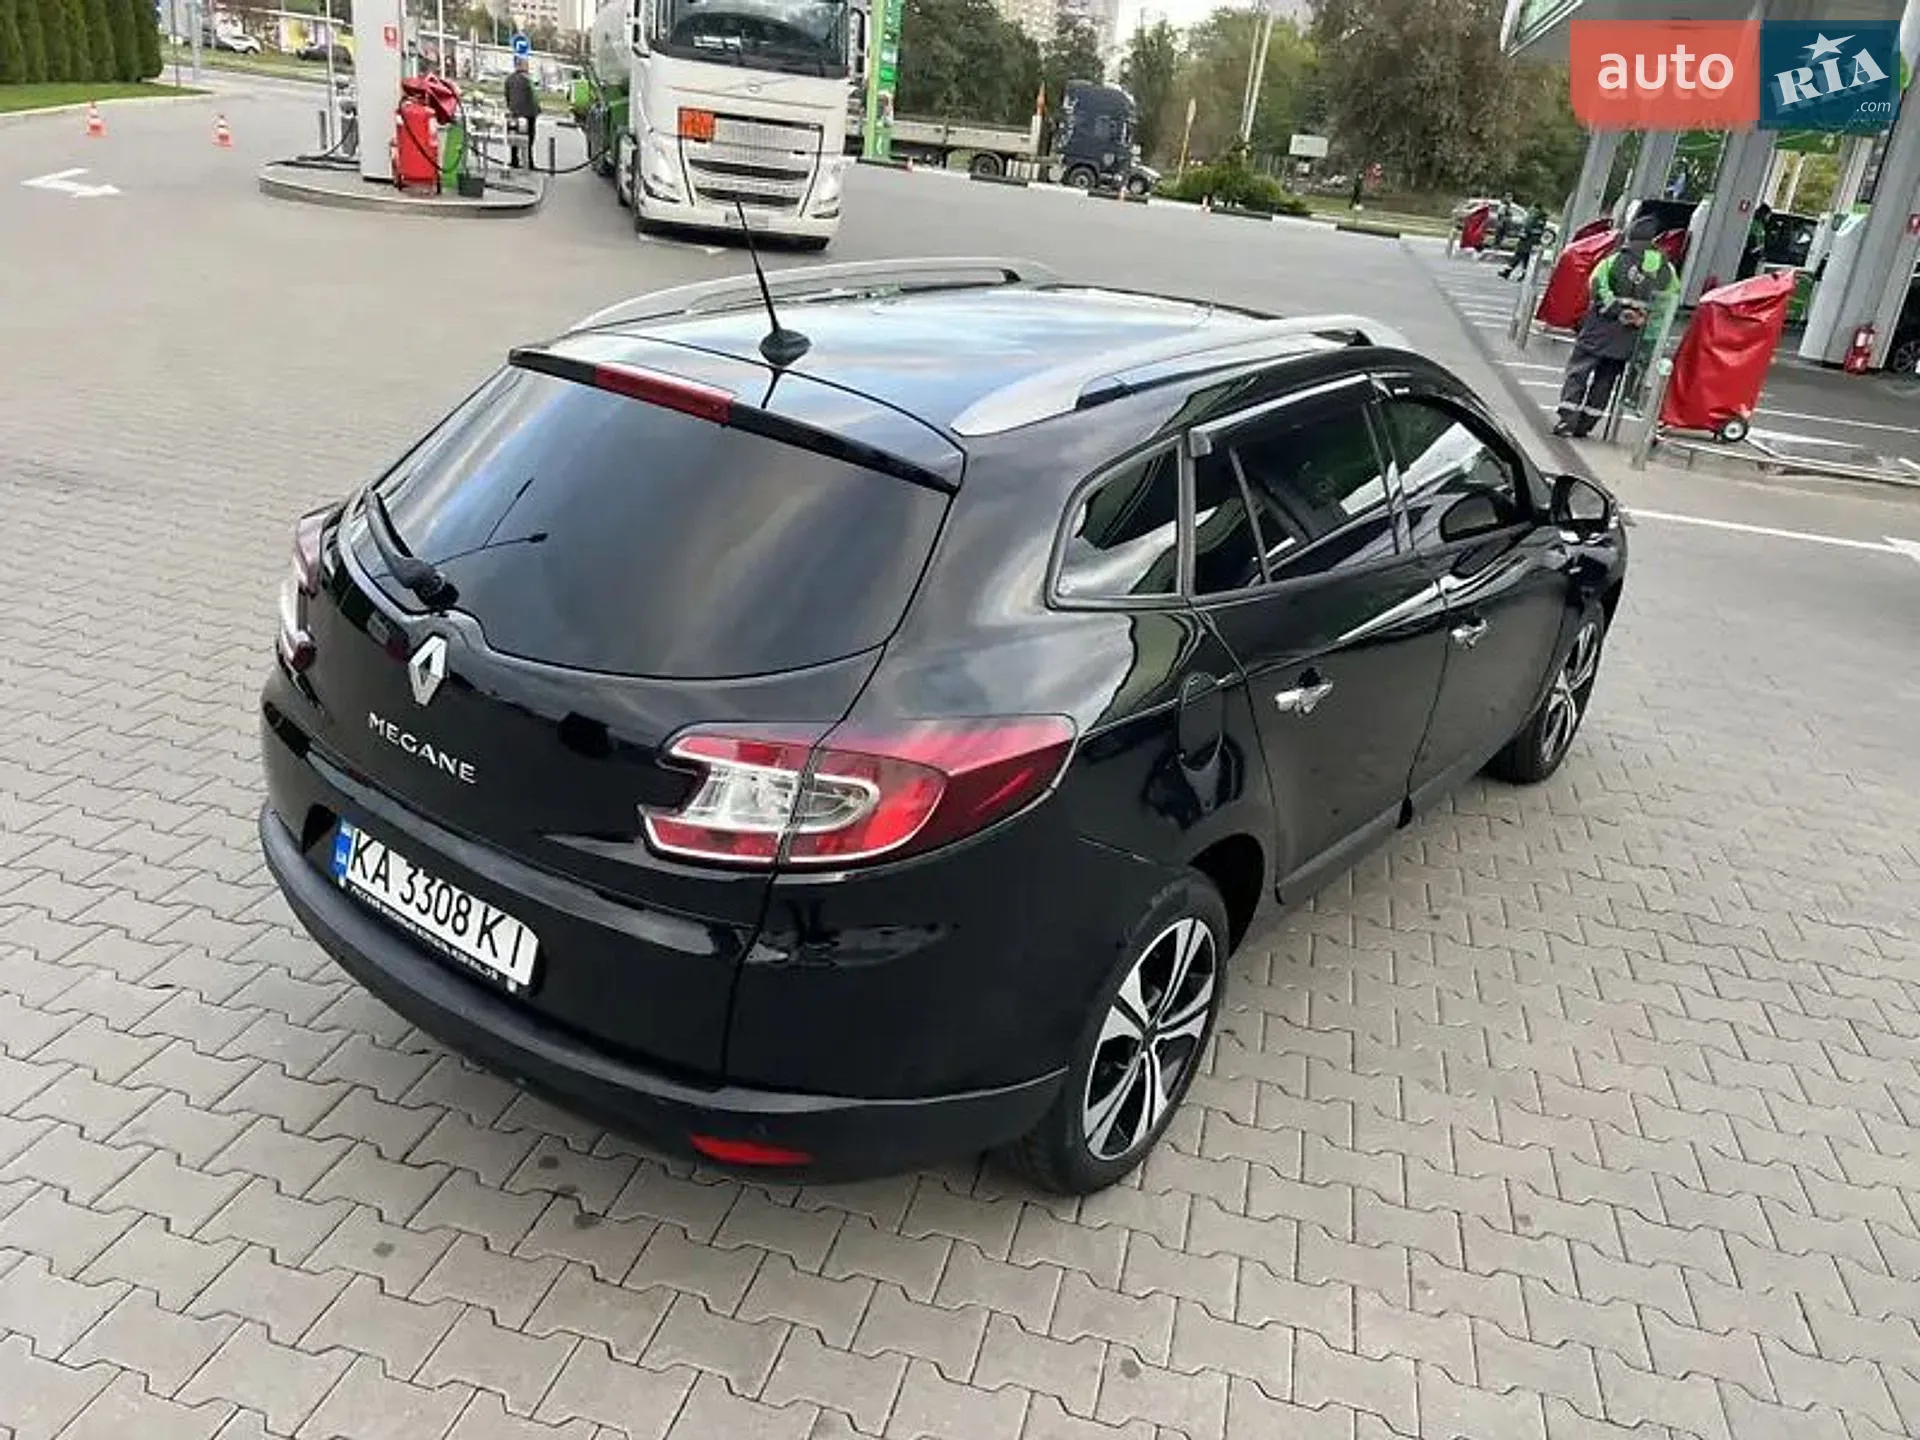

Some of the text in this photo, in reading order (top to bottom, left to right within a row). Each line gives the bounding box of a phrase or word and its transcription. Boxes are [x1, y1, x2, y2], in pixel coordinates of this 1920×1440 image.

[368, 711, 477, 784] MEGANE
[350, 829, 391, 894] KA
[399, 865, 472, 937] 3308
[477, 904, 526, 969] KI
